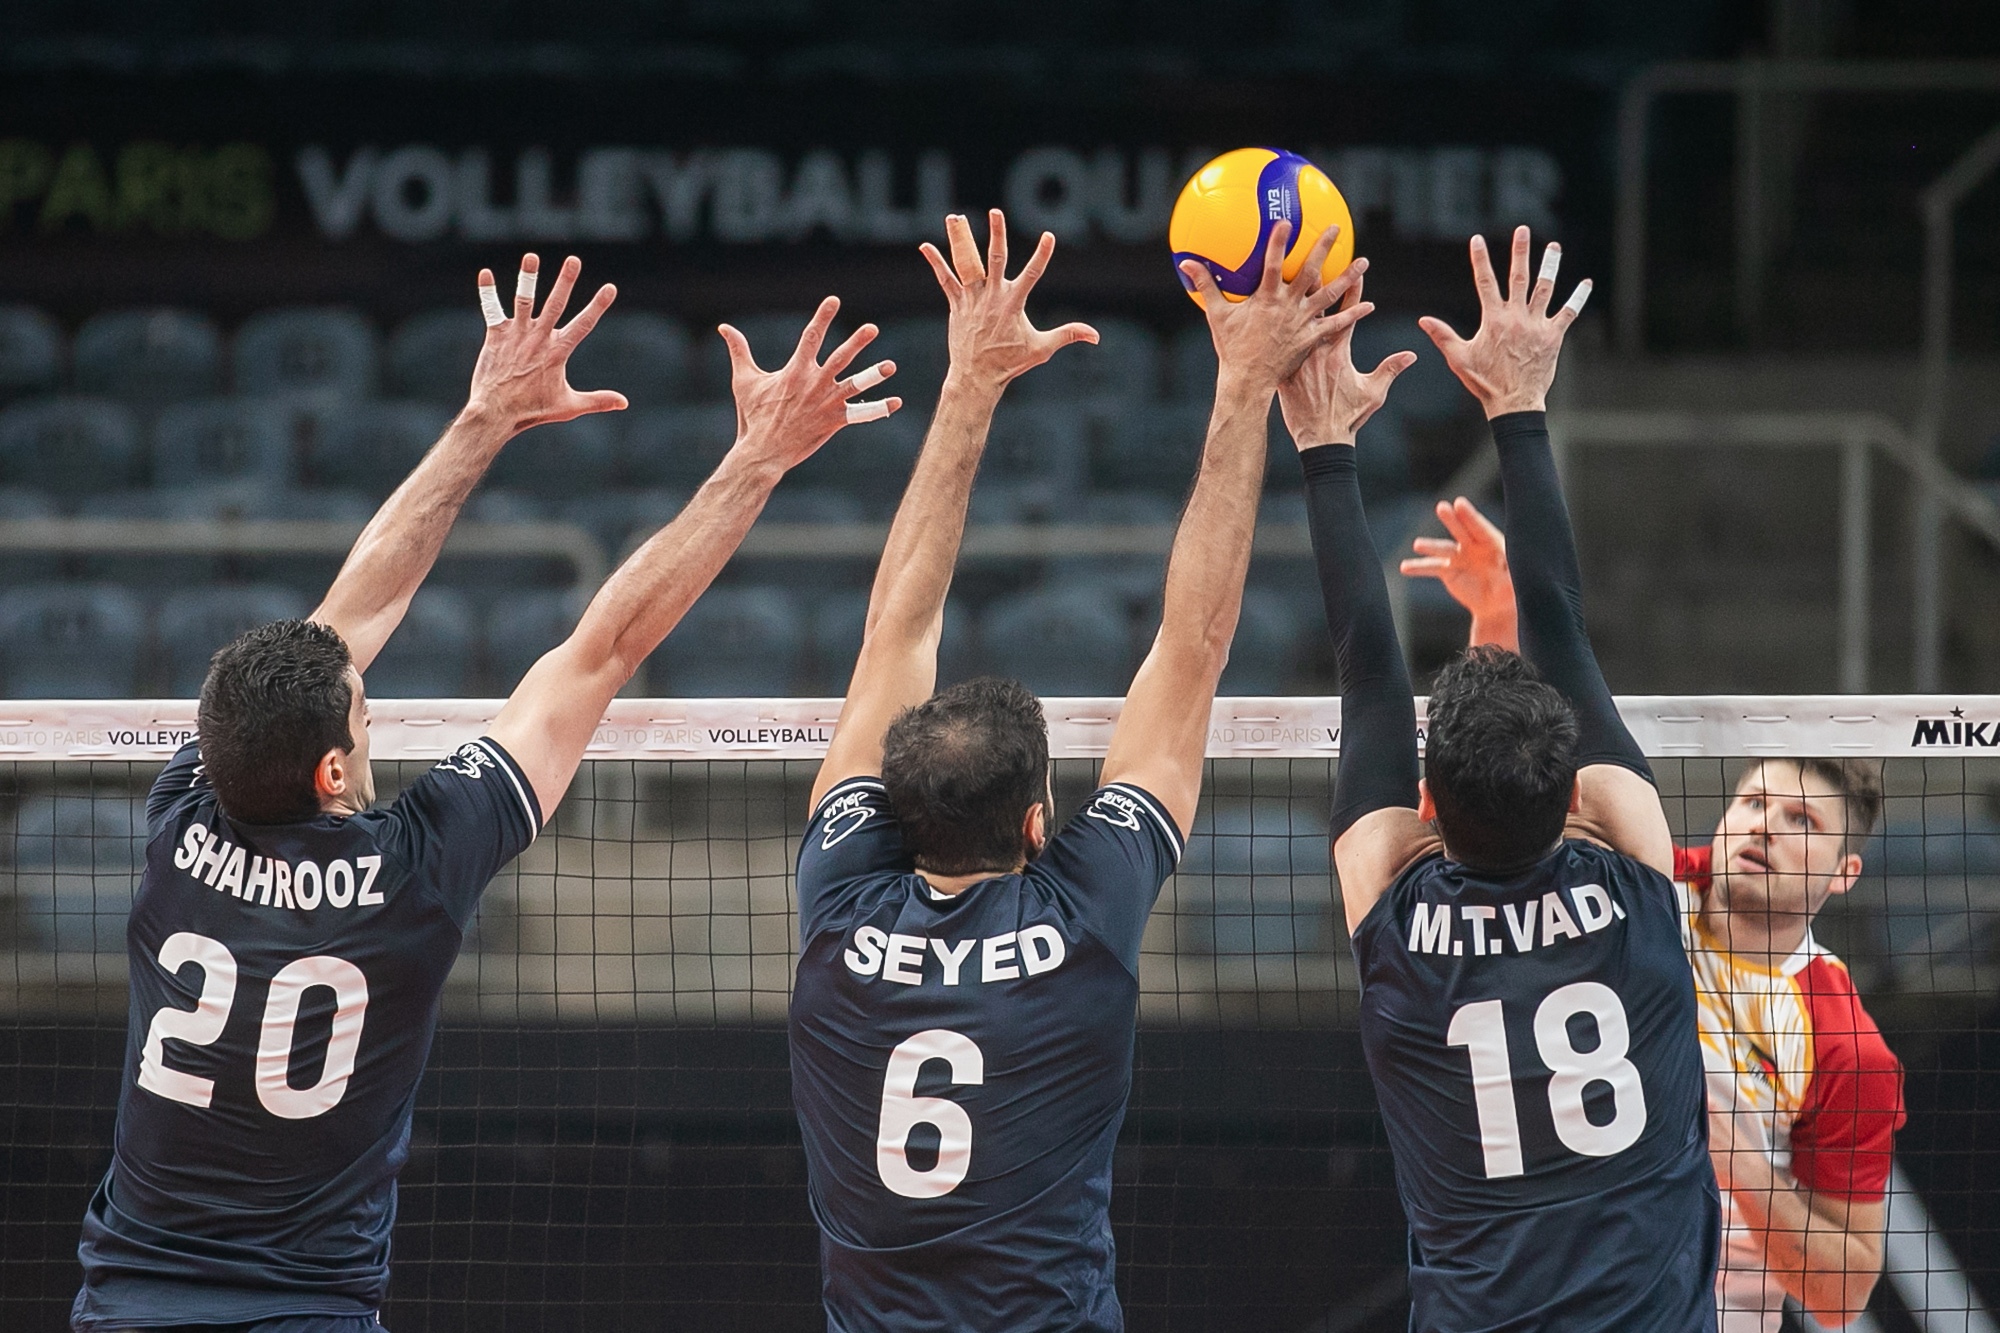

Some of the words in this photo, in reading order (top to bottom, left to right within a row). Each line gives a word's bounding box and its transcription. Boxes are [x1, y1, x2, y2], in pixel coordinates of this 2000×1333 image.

[298, 147, 953, 240] VOLLEYBALL
[1004, 146, 1562, 240] QUFIER
[1268, 188, 1282, 220] FIVB
[24, 731, 47, 745] TO
[53, 731, 102, 745] PARIS
[593, 730, 619, 744] AD
[624, 730, 648, 744] TO
[653, 730, 702, 744] PARIS
[708, 729, 829, 743] VOLLEYBALL
[1210, 729, 1235, 743] AD
[1242, 729, 1265, 743] TO
[1271, 728, 1321, 742] PARIS
[174, 823, 384, 910] SHAHROOZ
[844, 924, 1066, 986] SEYED
[137, 932, 368, 1119] 20
[877, 1029, 984, 1199] 6
[1447, 981, 1647, 1178] 18
